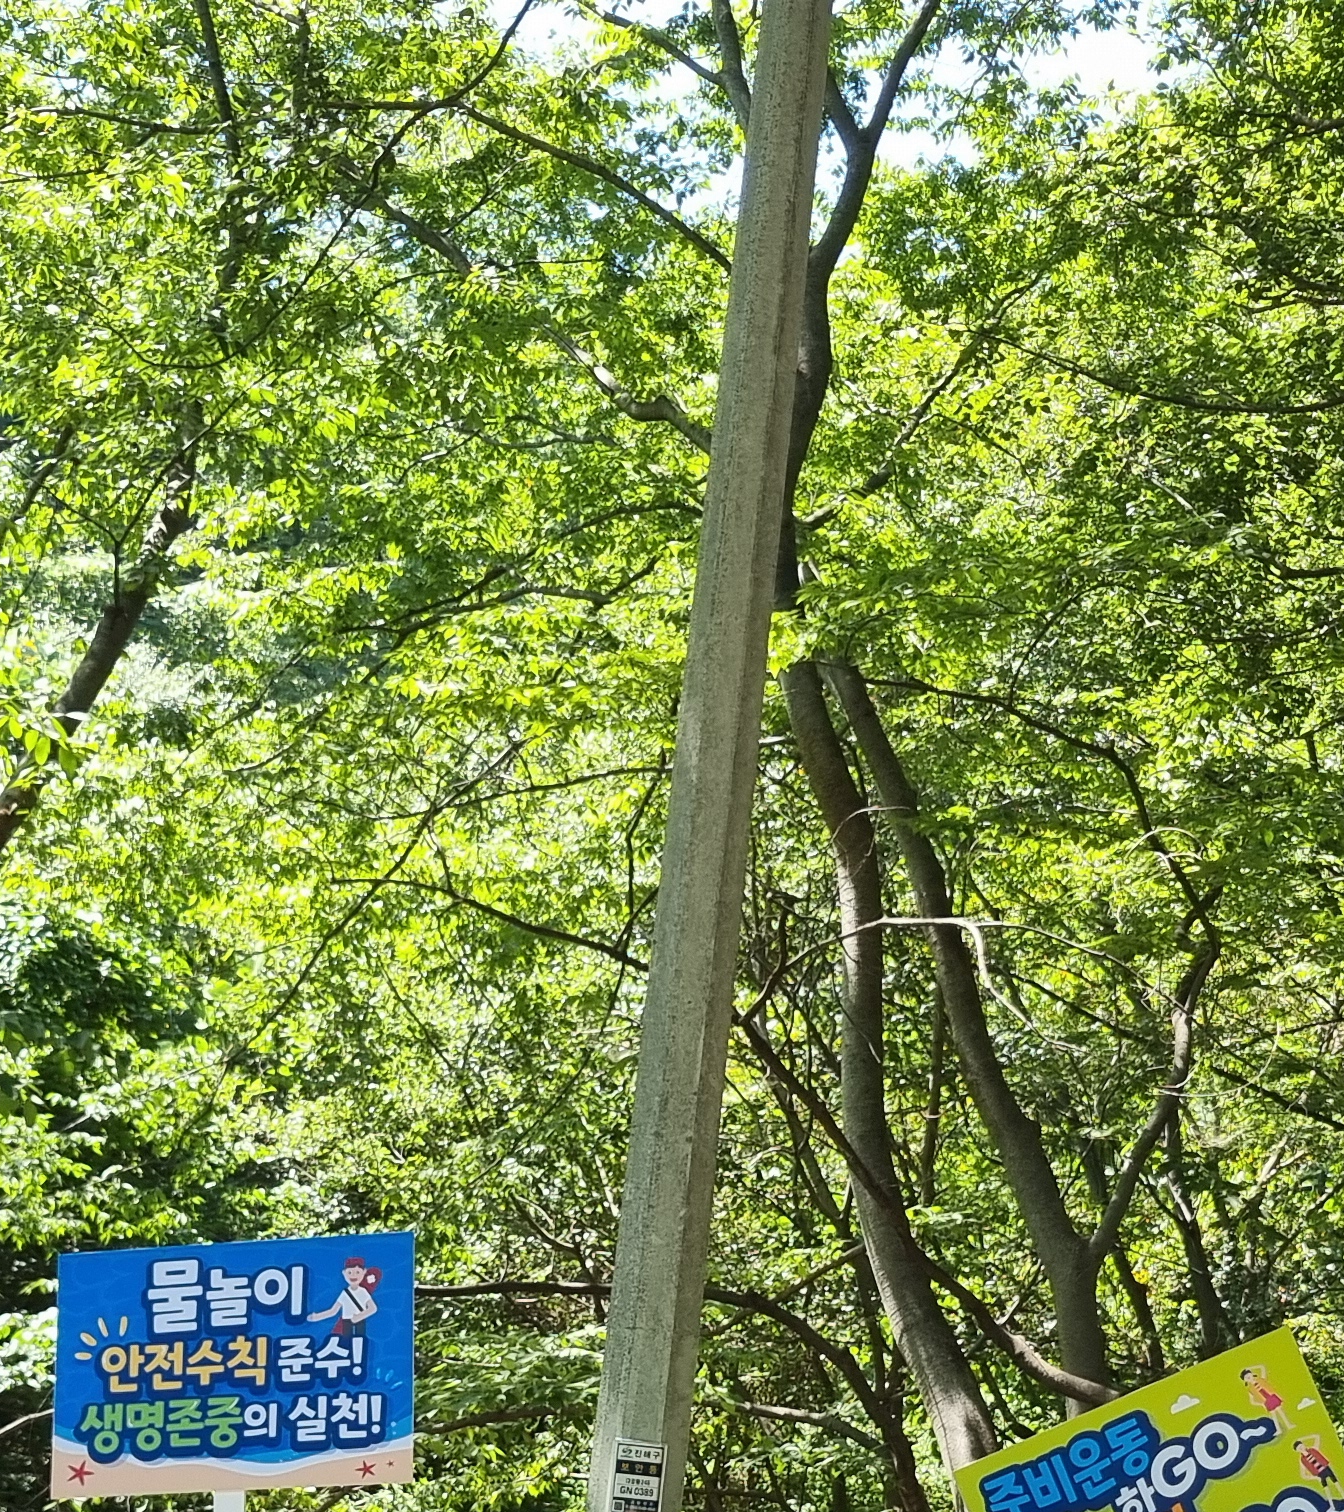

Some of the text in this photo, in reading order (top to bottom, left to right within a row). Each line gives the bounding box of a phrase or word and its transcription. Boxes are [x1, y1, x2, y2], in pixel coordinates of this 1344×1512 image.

[147, 1258, 305, 1335] 물놀이
[101, 1335, 365, 1393] 안전수칙 준수!
[79, 1392, 383, 1455] 생명존중의 실천!
